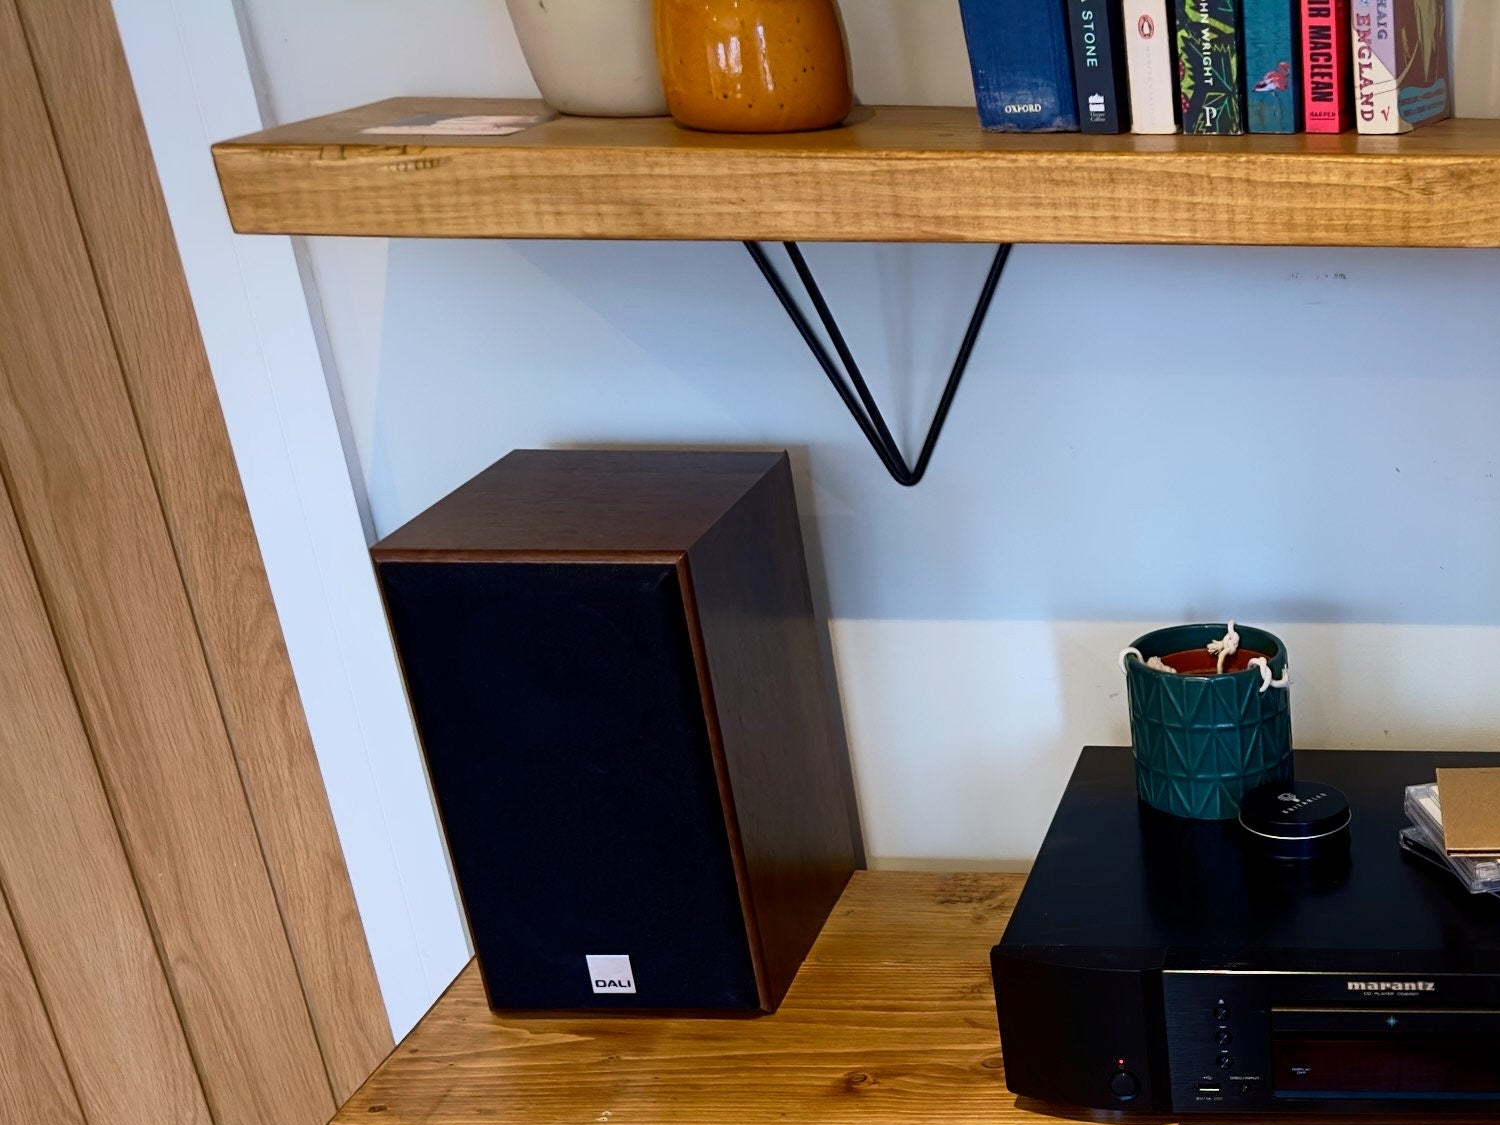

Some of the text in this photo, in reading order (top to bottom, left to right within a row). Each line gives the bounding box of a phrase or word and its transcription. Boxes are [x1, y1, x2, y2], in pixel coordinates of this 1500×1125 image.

[1081, 10, 1098, 68] STONE
[1200, 0, 1213, 86] HN WRIGHT
[1309, 25, 1334, 103] MACLEAN
[1356, 13, 1375, 122] ENGLAND
[1005, 104, 1042, 114] OXFORD
[595, 980, 631, 988] DALI
[1347, 981, 1435, 991] marantz
